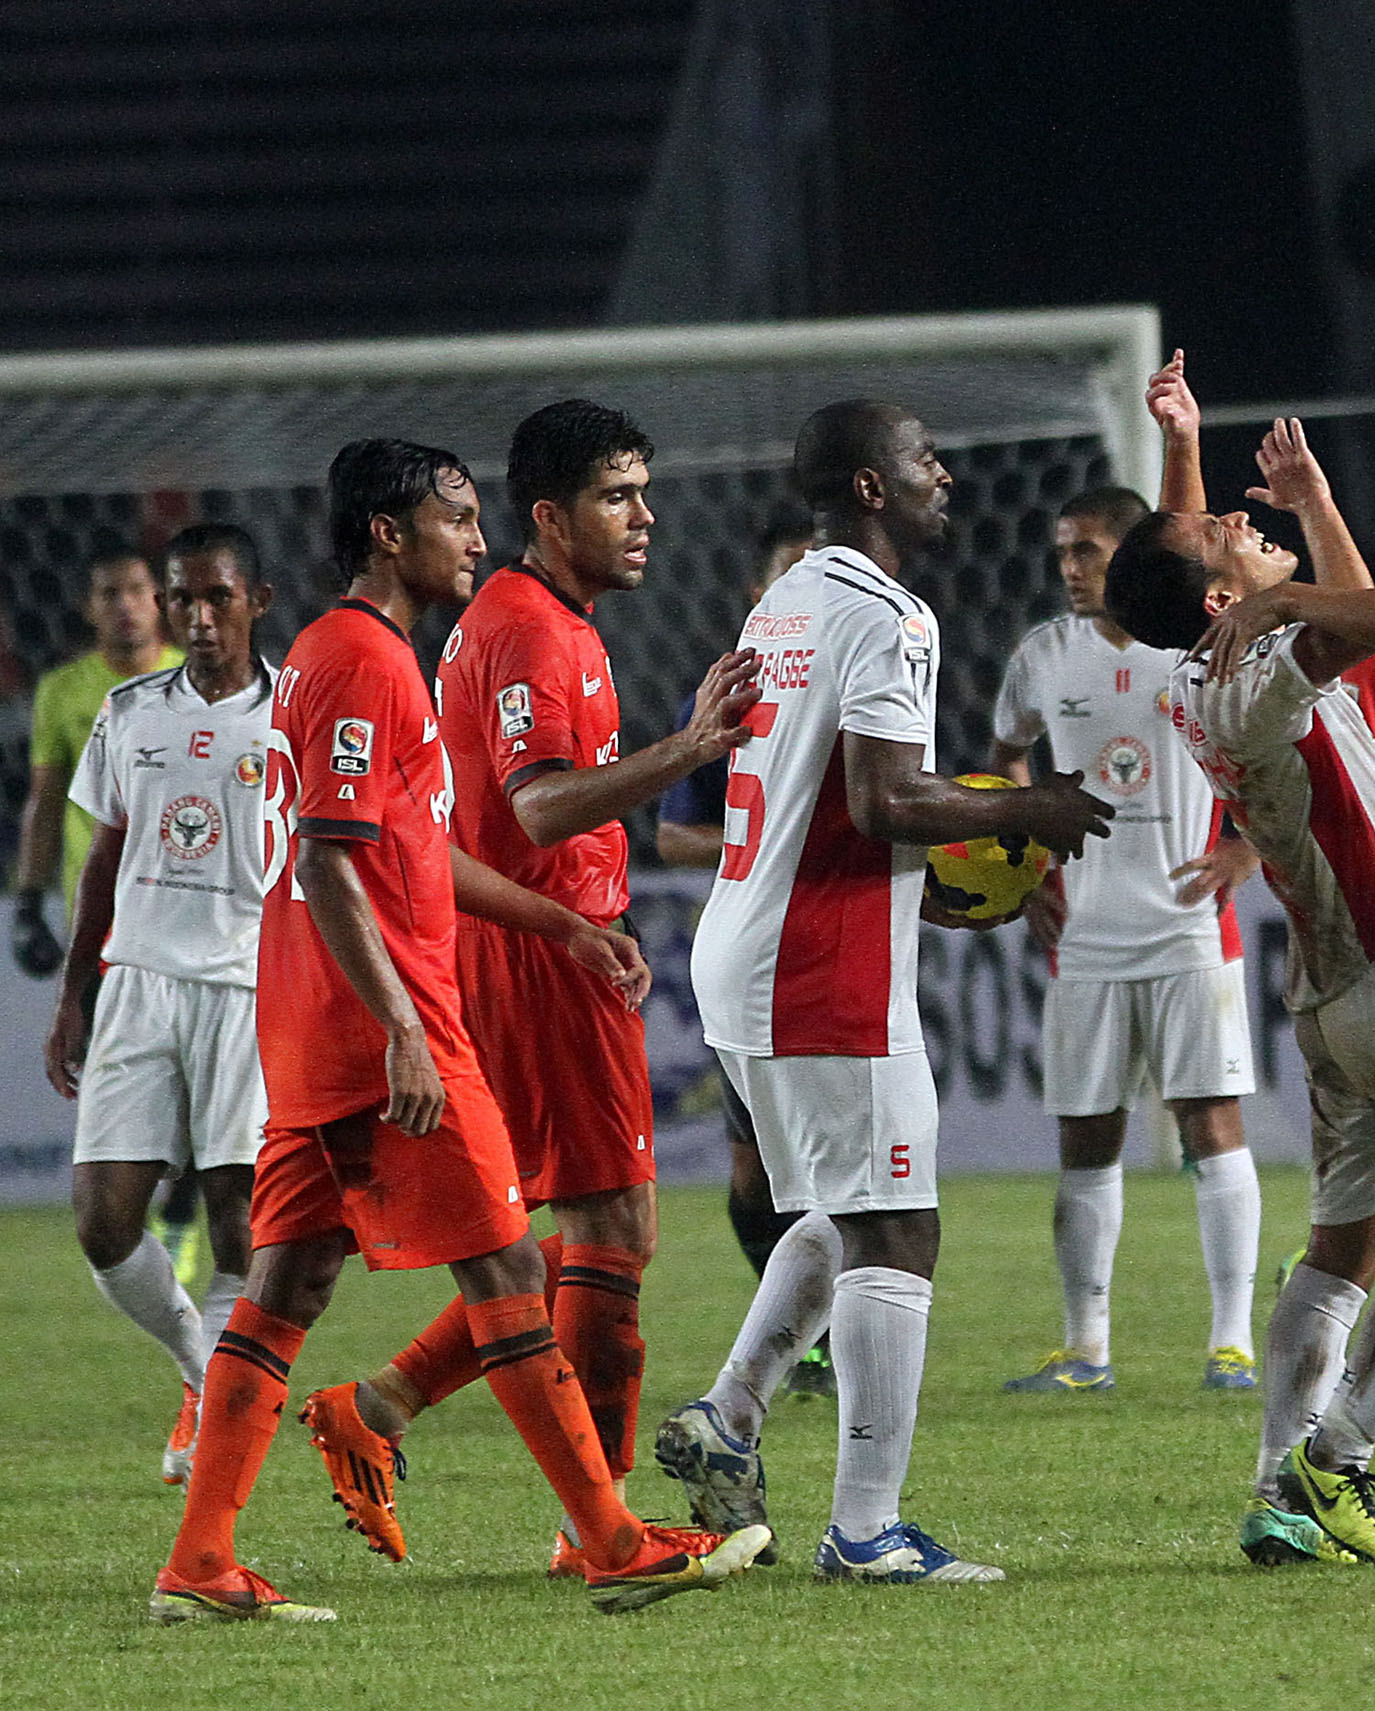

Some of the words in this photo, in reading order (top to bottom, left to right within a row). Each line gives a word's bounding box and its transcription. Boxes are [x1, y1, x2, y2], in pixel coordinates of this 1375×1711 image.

[909, 650, 928, 661] ISL
[506, 718, 529, 736] ISL
[187, 731, 215, 759] 12
[336, 757, 364, 772] ISL
[720, 702, 779, 882] 5
[890, 1144, 911, 1178] 5
